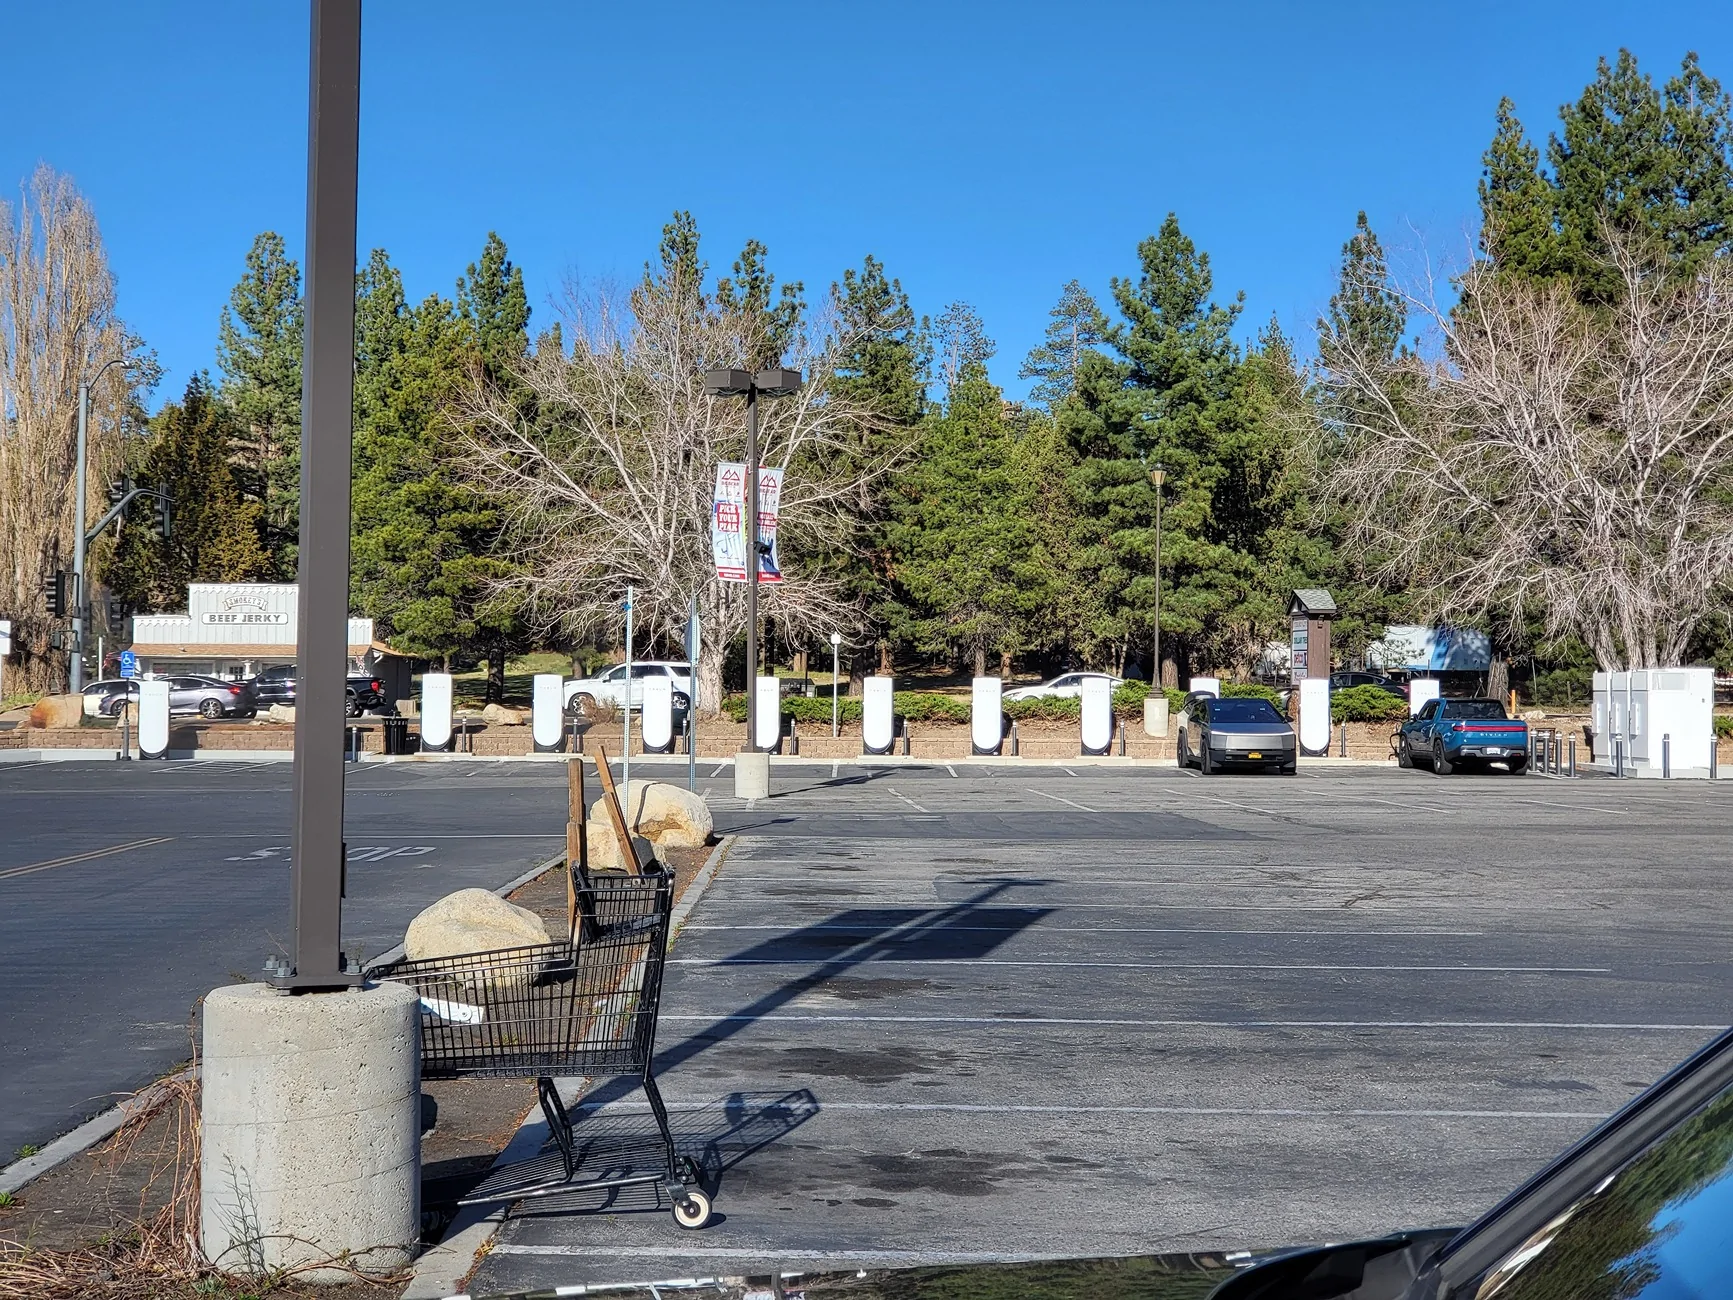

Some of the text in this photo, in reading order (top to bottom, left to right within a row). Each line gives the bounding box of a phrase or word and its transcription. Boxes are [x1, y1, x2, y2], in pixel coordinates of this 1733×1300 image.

[719, 504, 737, 513] PICK
[719, 513, 738, 522] YOUR
[209, 614, 281, 623] BEEF JERKY
[224, 846, 436, 862] SOP
